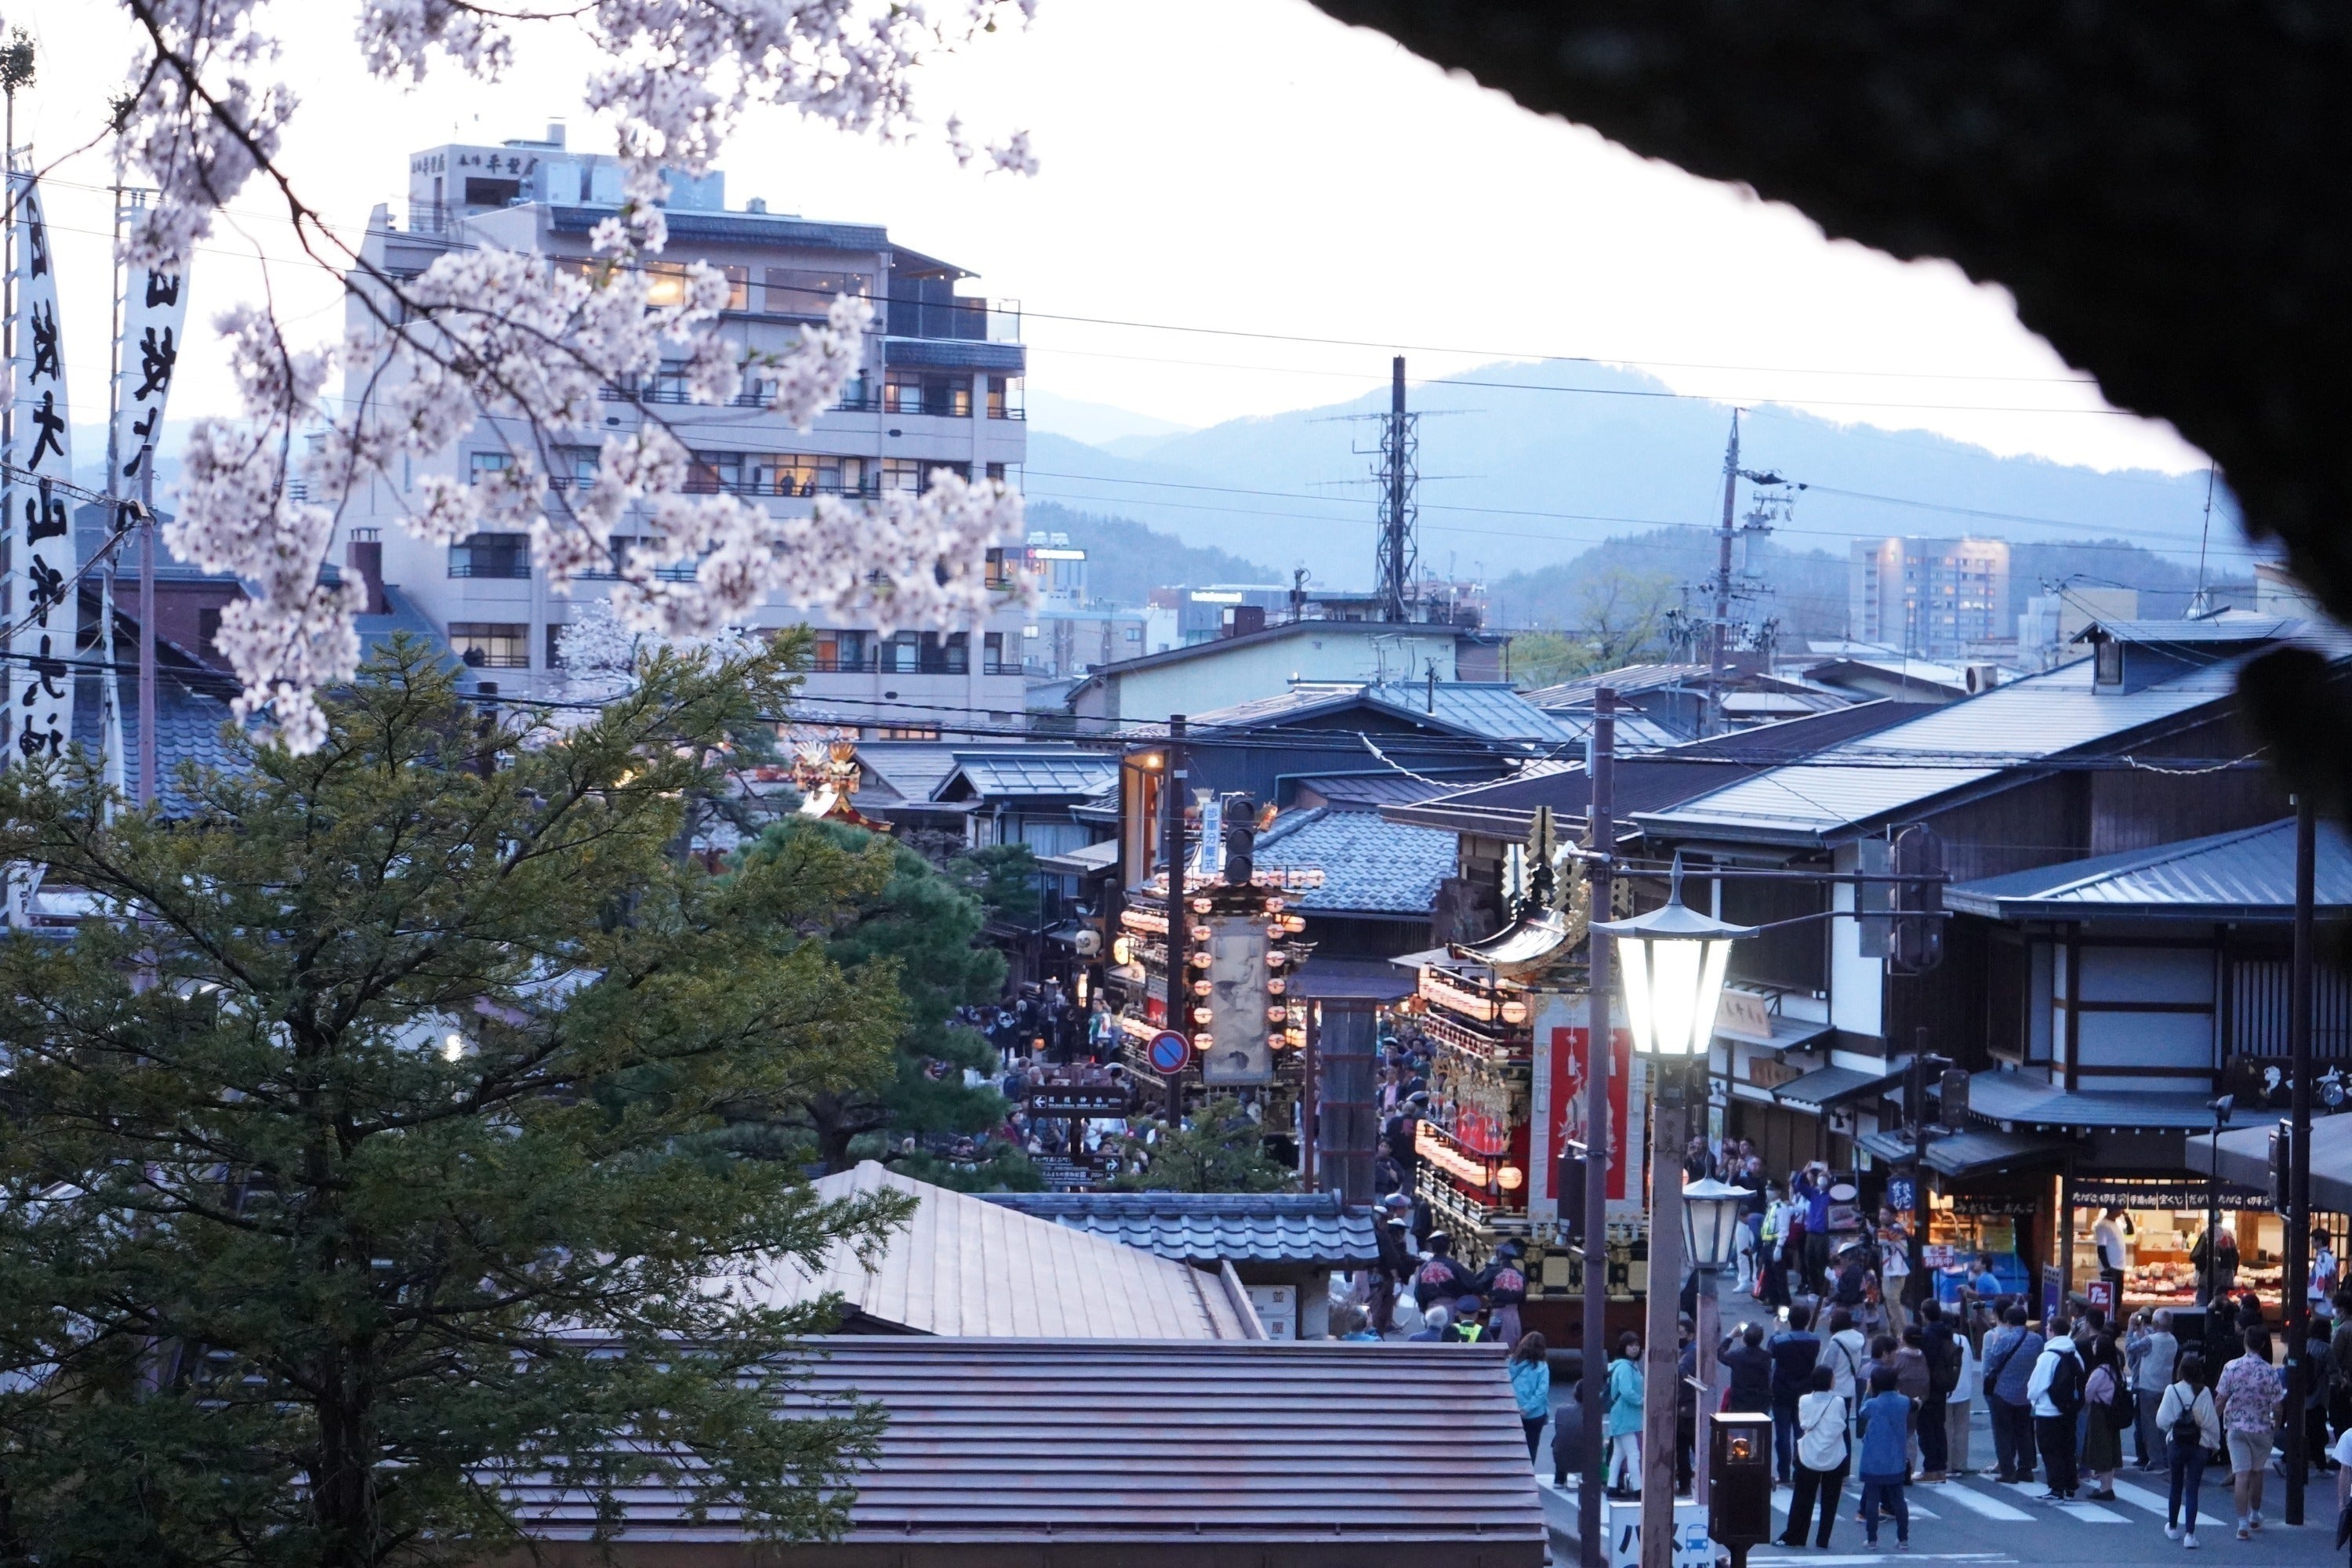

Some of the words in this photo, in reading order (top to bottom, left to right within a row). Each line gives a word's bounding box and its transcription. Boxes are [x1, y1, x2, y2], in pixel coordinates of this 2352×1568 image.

[1205, 808, 1218, 869] 歩車分離式
[2072, 1192, 2097, 1203] たばこ
[2158, 1193, 2183, 1205] 宝くじ
